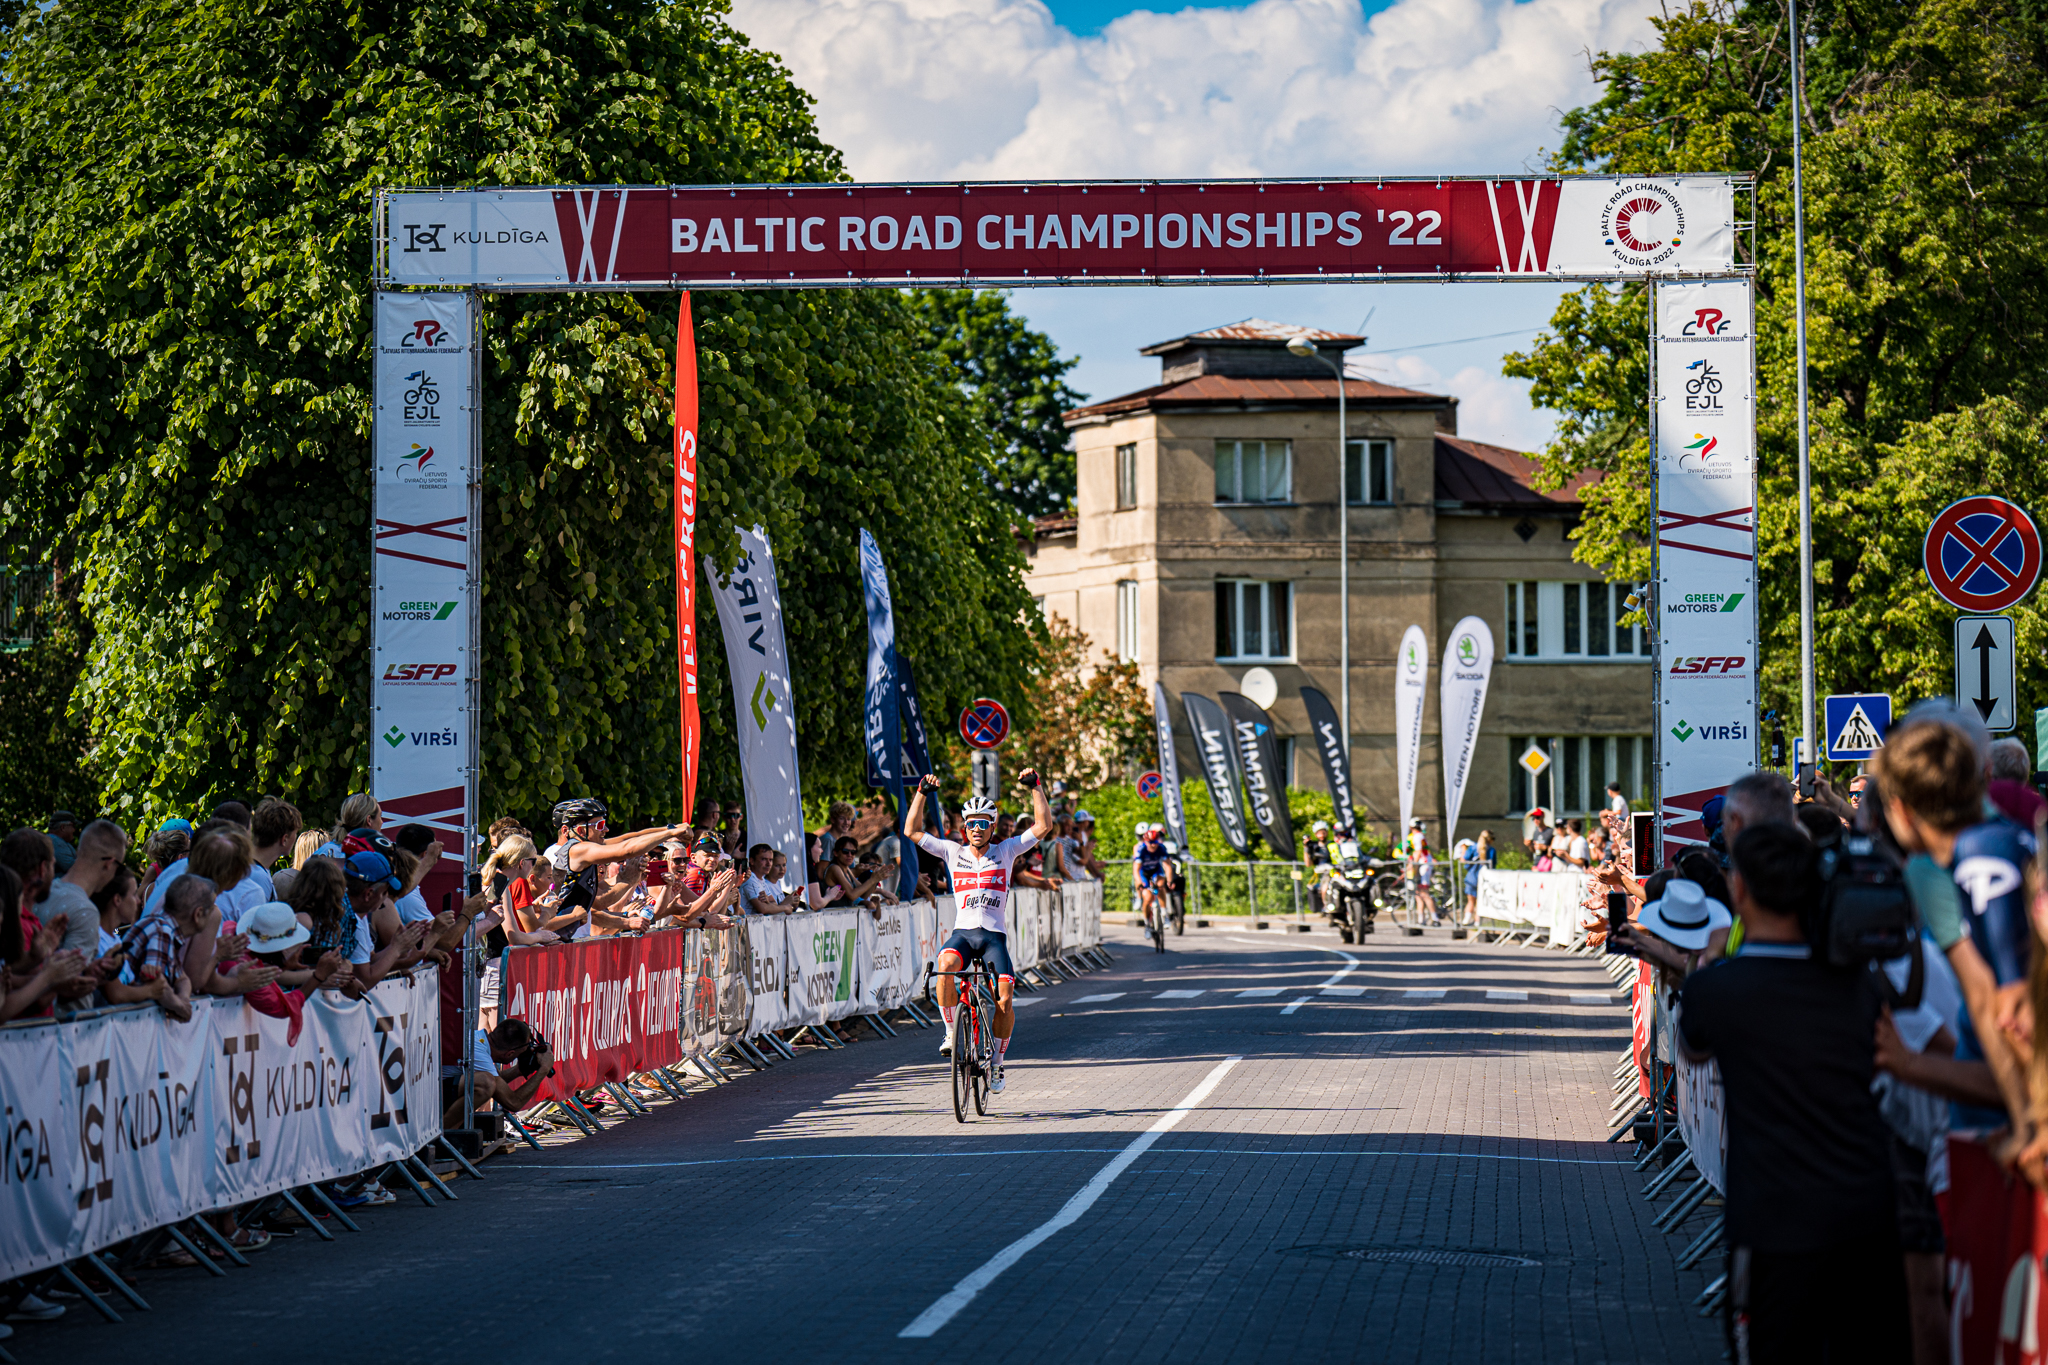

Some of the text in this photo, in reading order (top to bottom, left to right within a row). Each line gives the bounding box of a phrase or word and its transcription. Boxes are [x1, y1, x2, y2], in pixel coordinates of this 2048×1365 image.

[1601, 183, 1685, 236] BALTIC ROAD CHAMPIONSHIPS
[453, 227, 549, 245] KULDĪGA
[672, 208, 1443, 254] BALTIC ROAD CHAMPIONSHIPS '22
[1612, 247, 1675, 267] KULDĪGA 2022
[1686, 395, 1723, 409] EJL
[404, 406, 440, 420] EJL
[399, 601, 438, 611] GREEN
[1684, 593, 1724, 603] GREEN
[382, 611, 431, 621] MOTORS
[1667, 603, 1717, 613] MOTORS
[382, 663, 458, 681] LSFP
[1669, 656, 1746, 674] LSFP
[410, 727, 458, 746] VIRŠI
[1699, 721, 1747, 740] VIRŠI
[954, 875, 1005, 887] TREK
[266, 1047, 351, 1119] KULDĪGA
[114, 1071, 198, 1154] KULDĪGA
